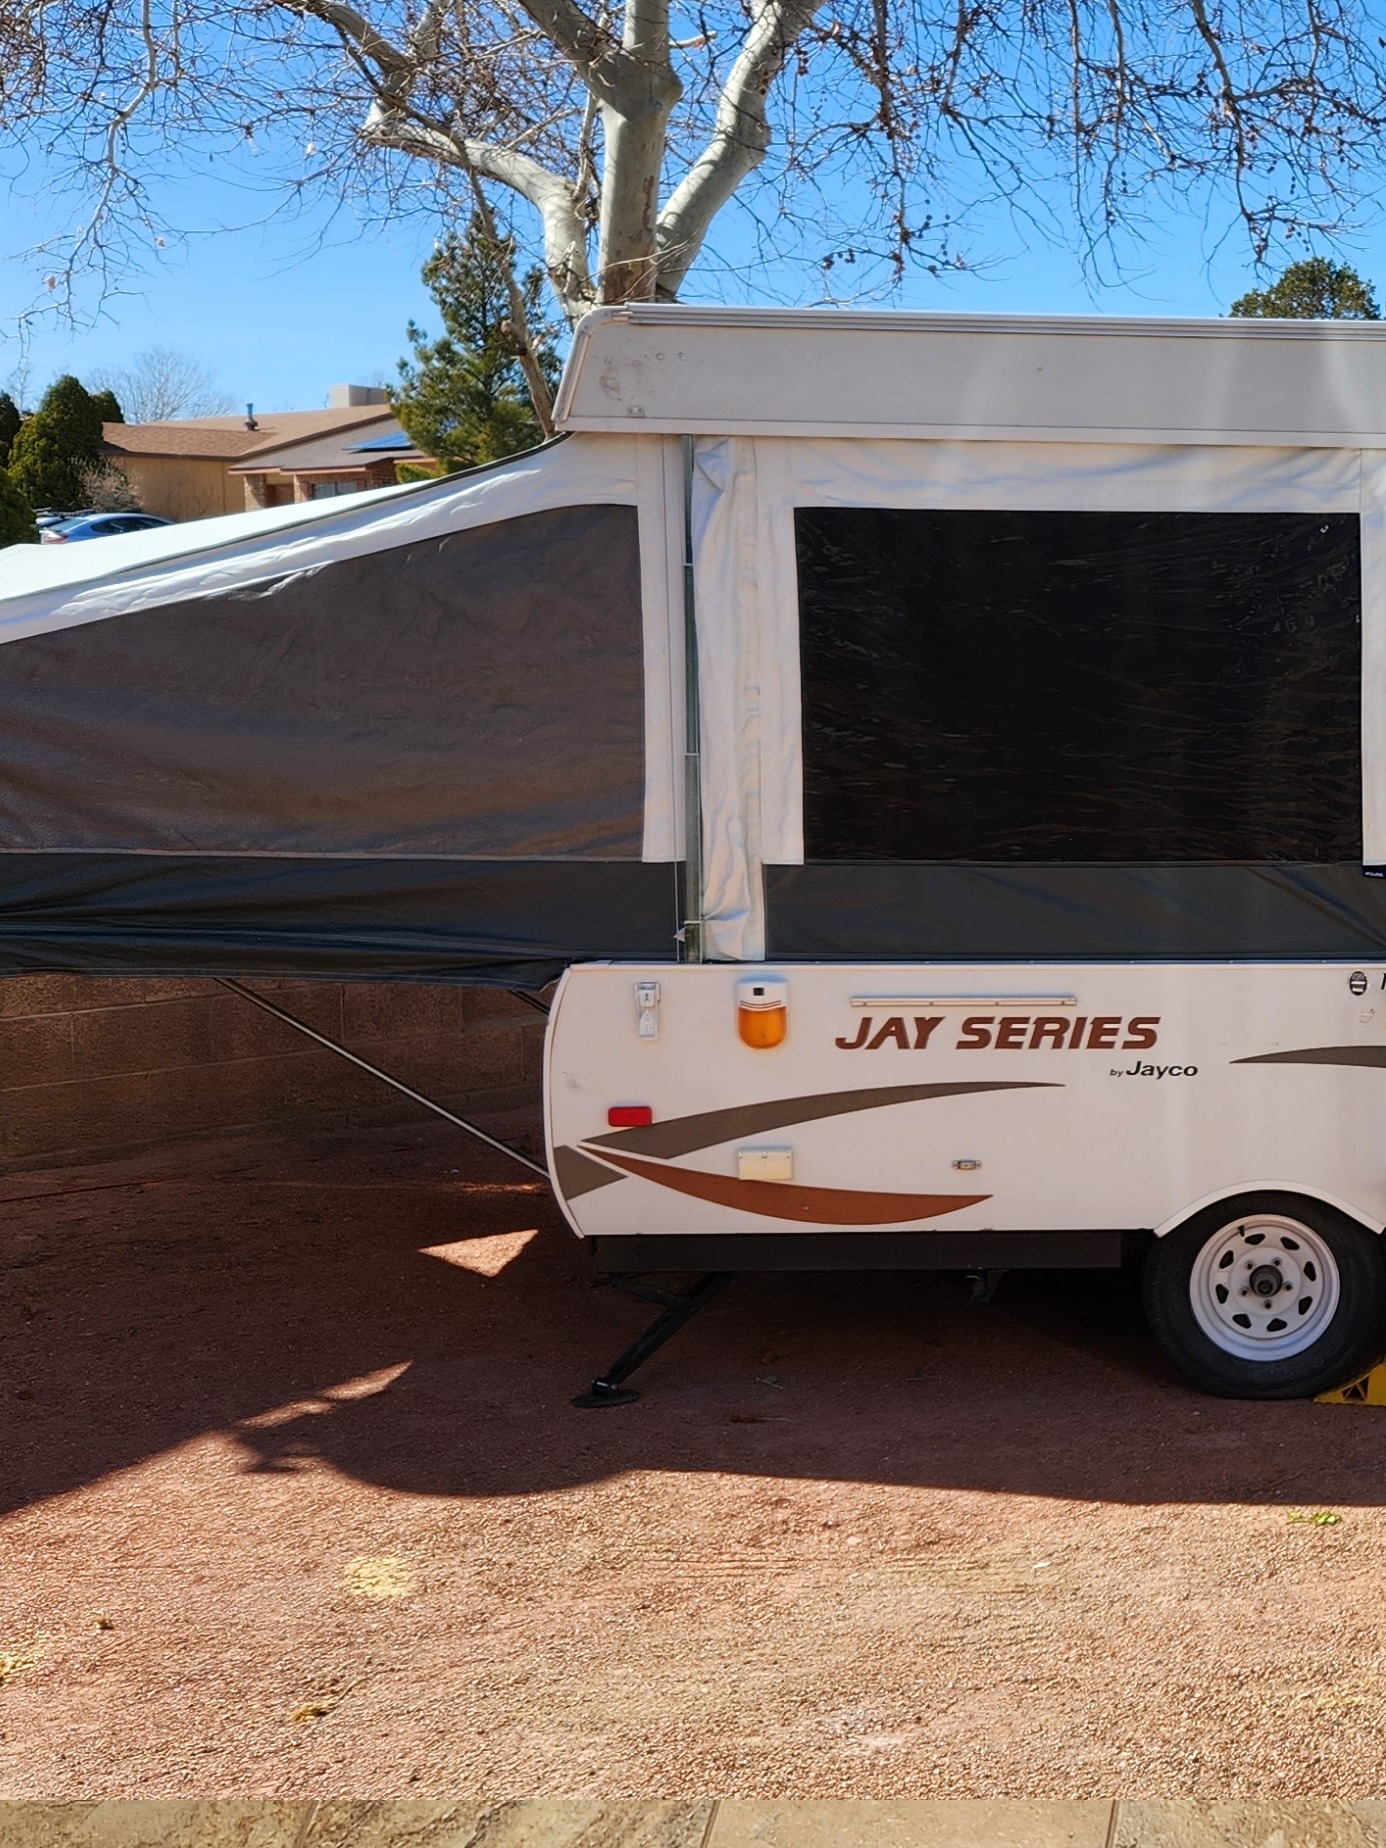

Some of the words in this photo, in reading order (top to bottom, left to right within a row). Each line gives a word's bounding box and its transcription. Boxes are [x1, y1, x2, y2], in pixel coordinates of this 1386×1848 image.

[835, 1016, 946, 1050] JAY
[955, 1016, 1161, 1050] SERIES
[1109, 1068, 1124, 1078] by
[1126, 1060, 1198, 1080] Jayco
